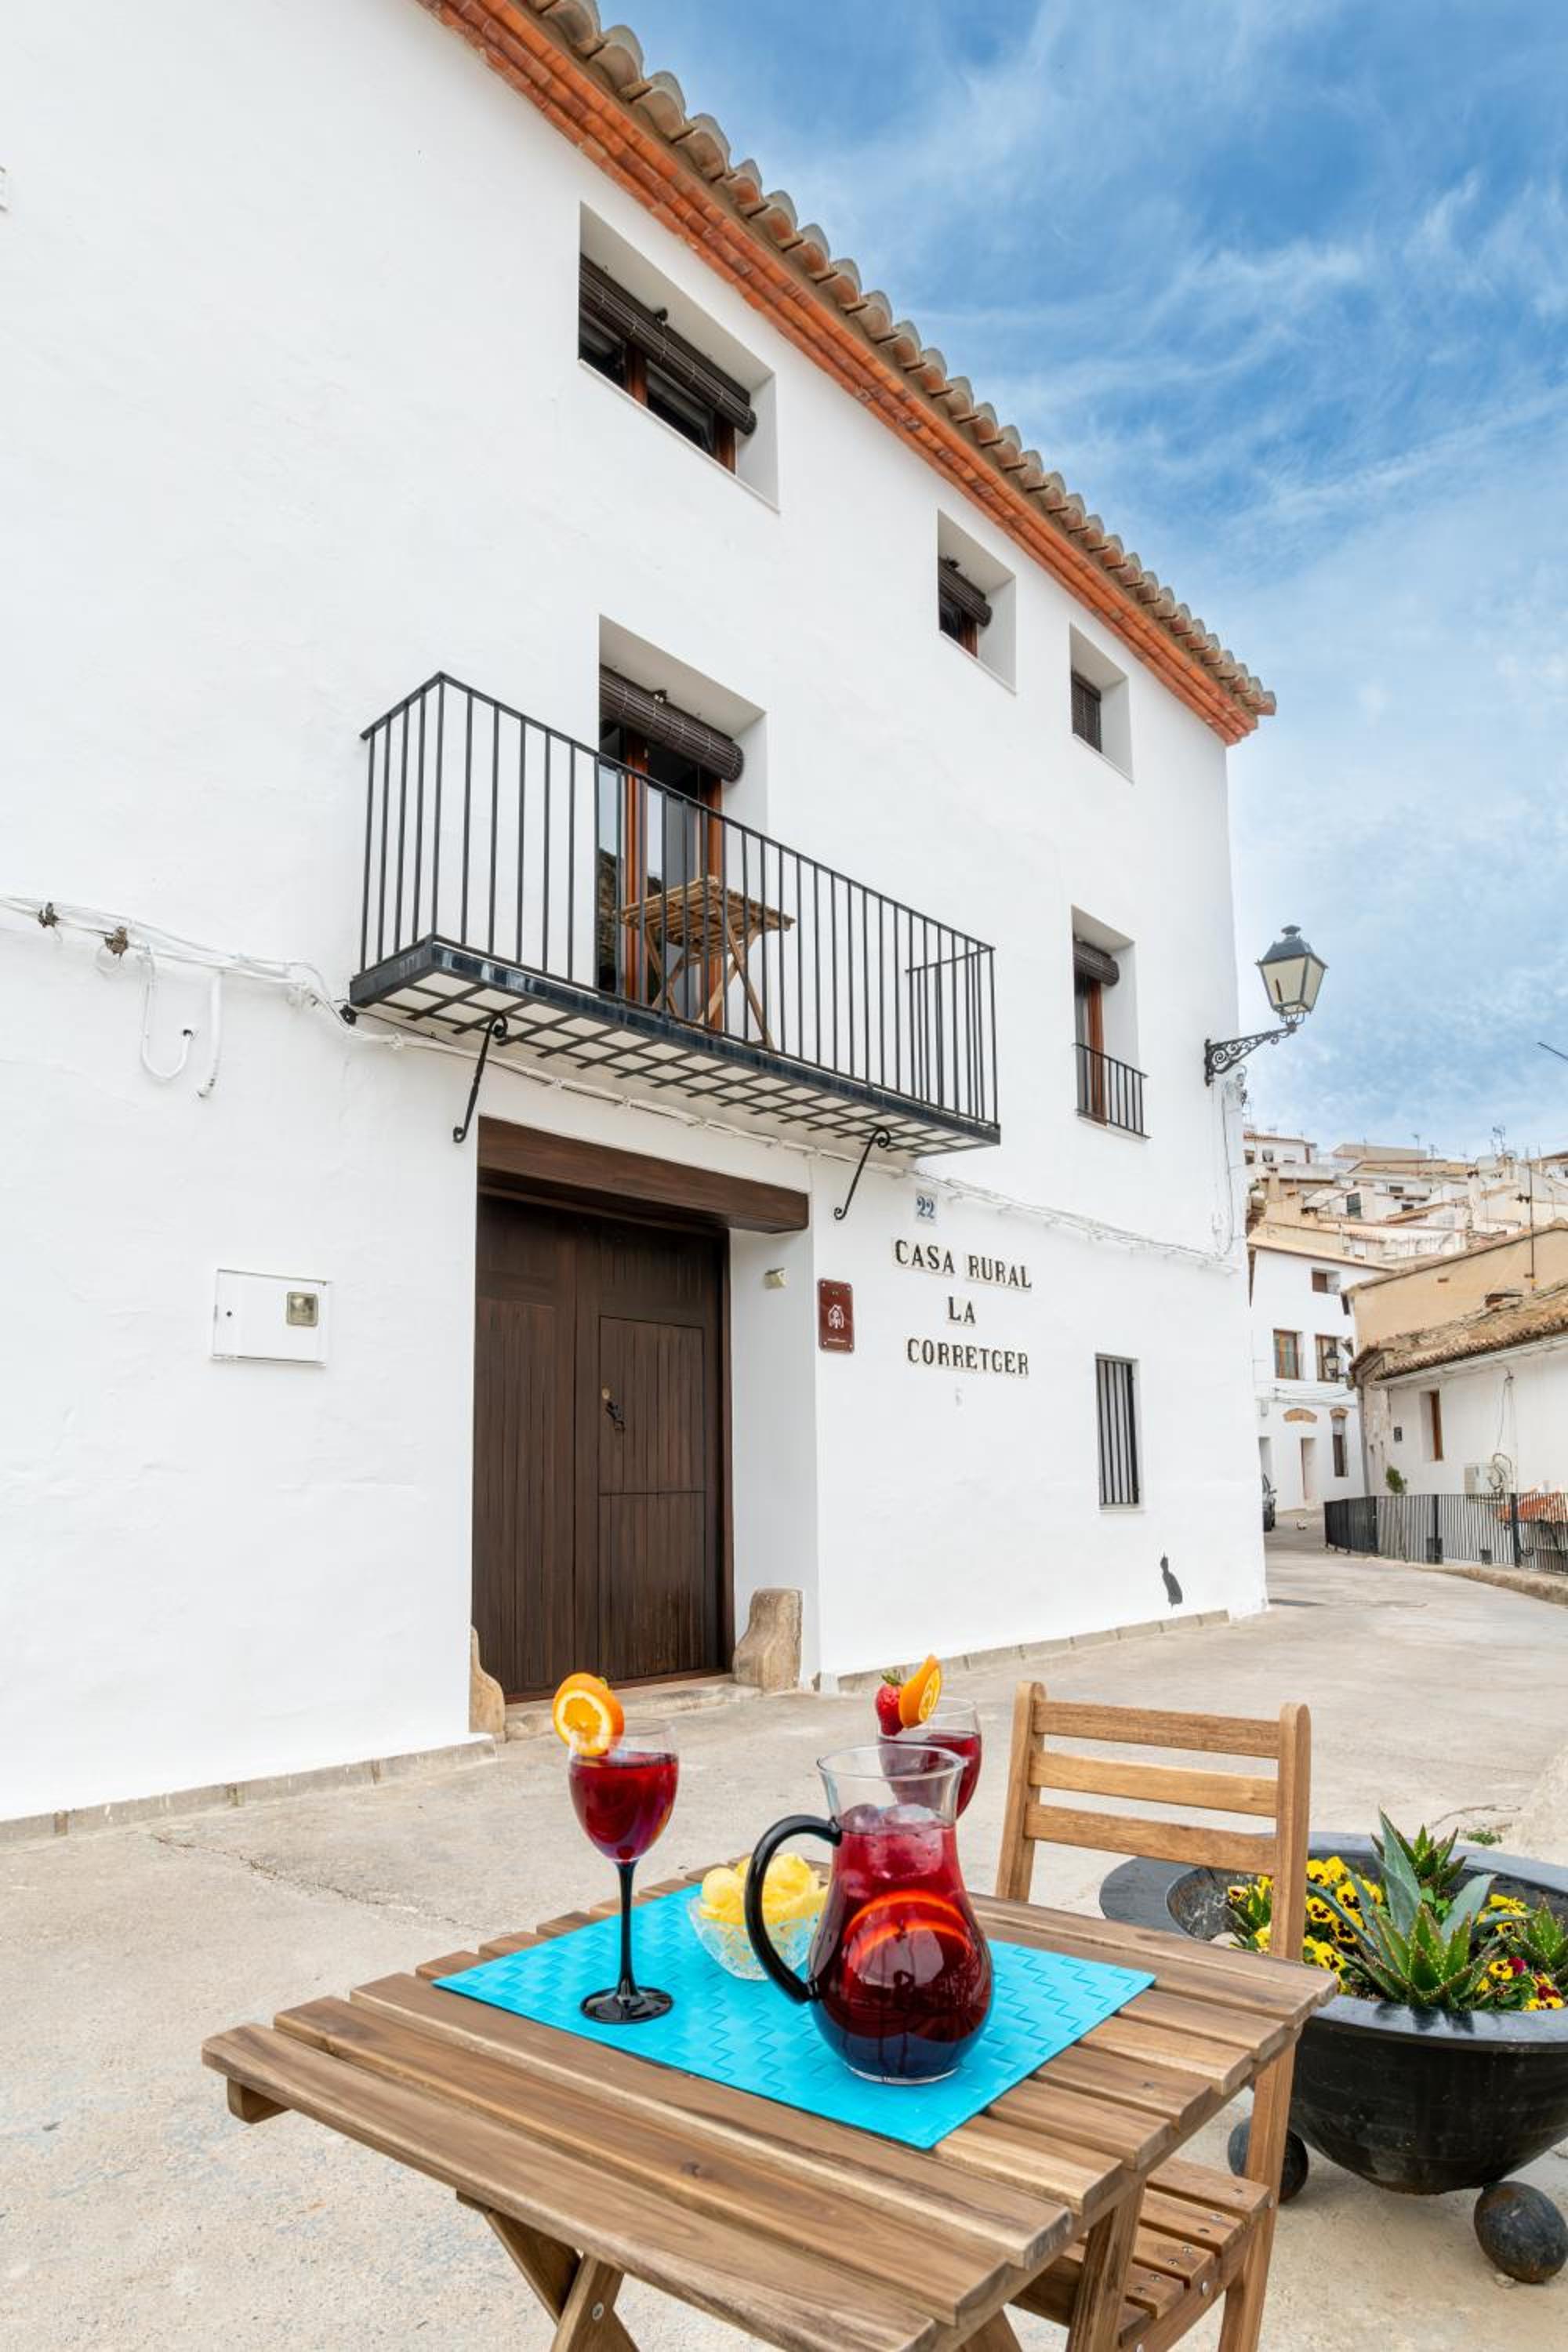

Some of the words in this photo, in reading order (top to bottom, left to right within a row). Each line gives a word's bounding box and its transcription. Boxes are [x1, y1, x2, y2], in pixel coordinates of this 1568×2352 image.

[916, 1196, 935, 1219] 22
[895, 1240, 955, 1274] CASA
[968, 1254, 1032, 1288] RURAL
[948, 1296, 975, 1323] LA
[907, 1338, 1029, 1375] CORRETGER
